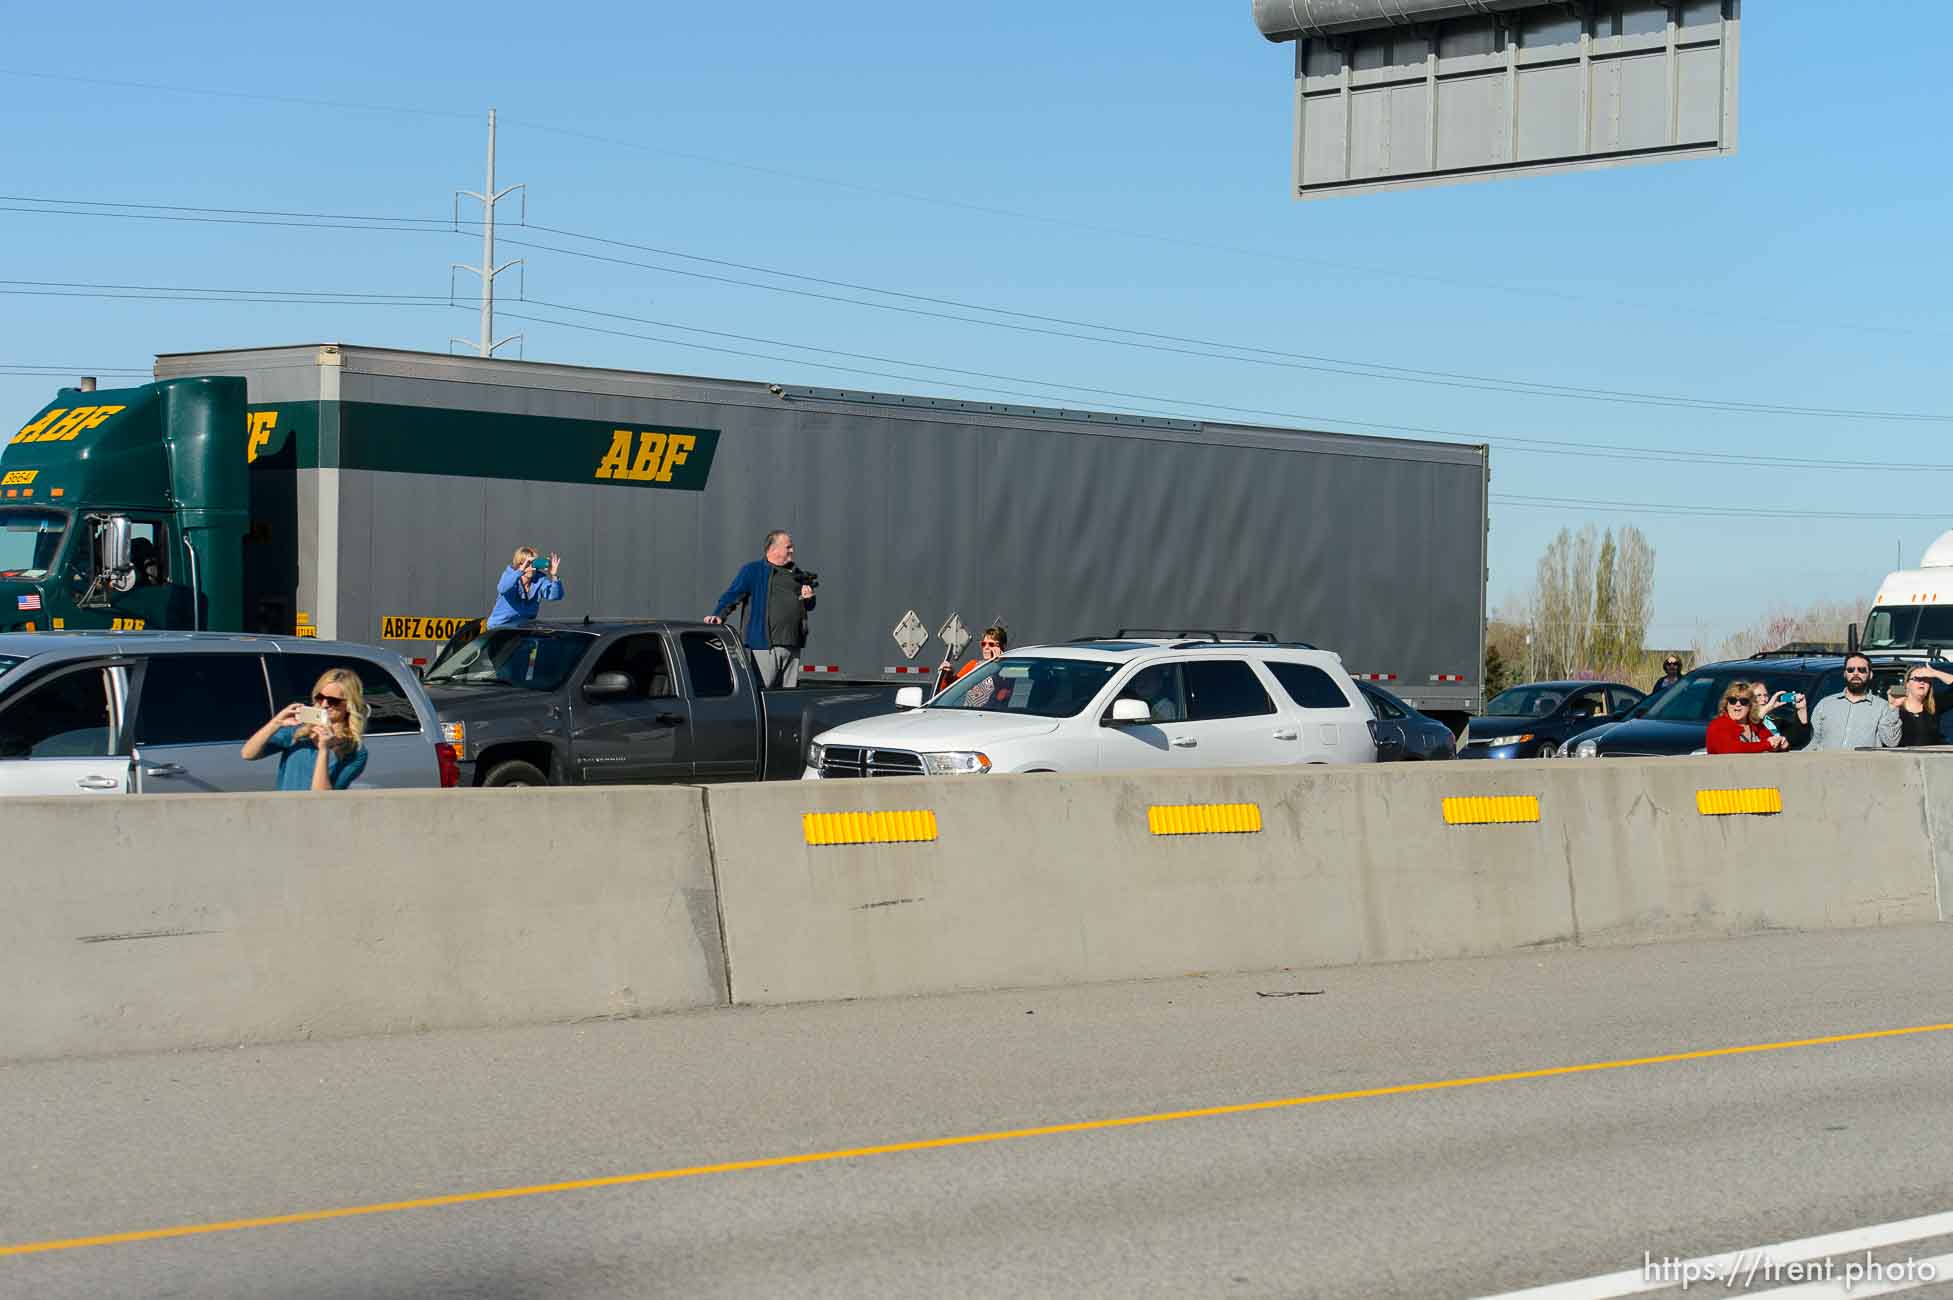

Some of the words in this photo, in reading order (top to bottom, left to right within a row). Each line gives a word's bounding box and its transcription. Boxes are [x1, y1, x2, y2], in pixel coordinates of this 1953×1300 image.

[8, 405, 127, 444] ABF
[247, 411, 278, 464] F
[595, 430, 697, 482] ABF
[384, 618, 421, 638] ABFZ
[425, 619, 481, 639] 660
